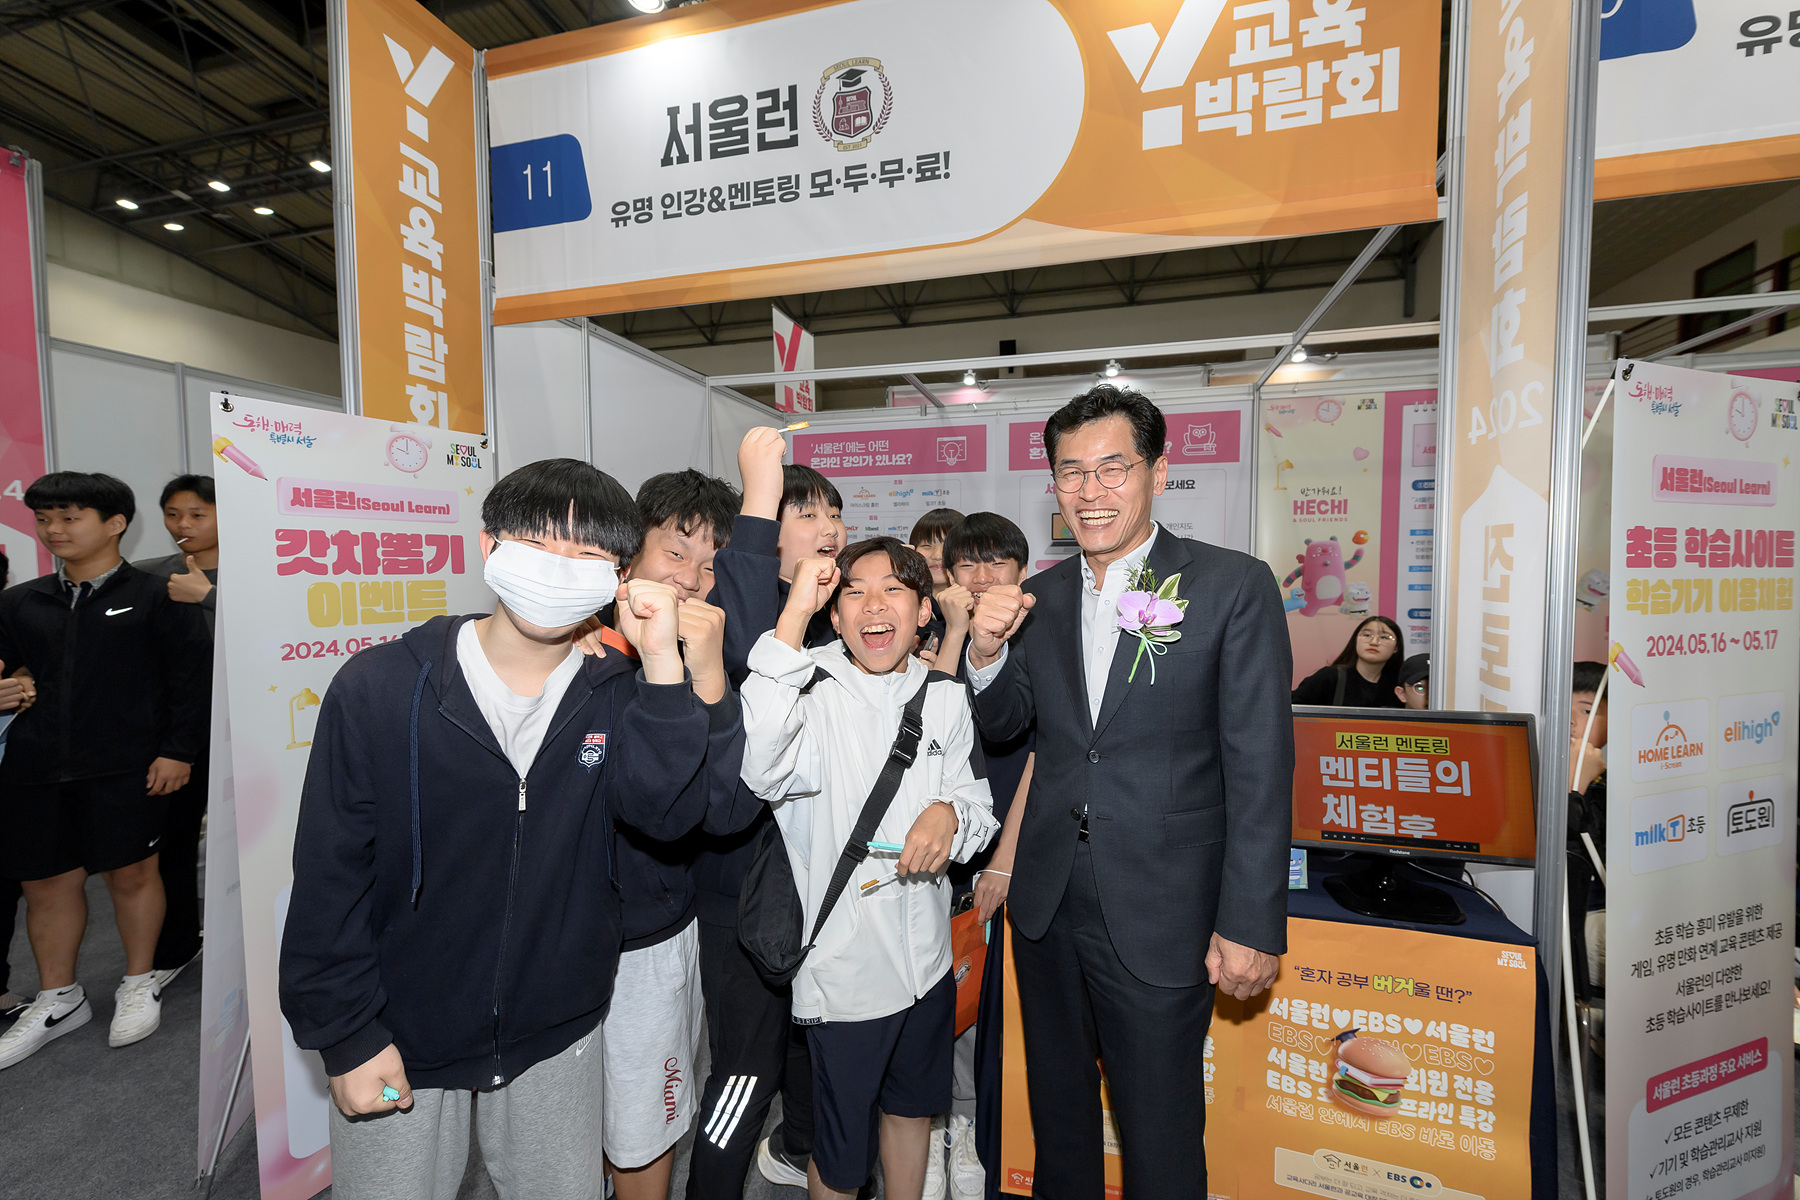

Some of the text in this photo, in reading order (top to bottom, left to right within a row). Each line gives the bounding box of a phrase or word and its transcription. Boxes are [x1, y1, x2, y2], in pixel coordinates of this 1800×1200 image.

[1195, 46, 1400, 136] 박람회
[660, 84, 799, 167] 서울런
[522, 160, 554, 201] 11
[610, 151, 951, 228] 유명 인강&멘토링 모·두·무·료!
[398, 141, 449, 428] 교육박람회
[269, 432, 318, 448] 특별시 서울
[810, 453, 913, 469] 온라인 강의가 있나요?
[868, 440, 889, 452] 어떤
[1293, 499, 1348, 515] HECHI
[1300, 486, 1342, 497] 반가워요!
[1739, 478, 1771, 496] Learn)
[408, 501, 450, 516] Learn)
[275, 528, 466, 576] 갓챠뽑기
[1626, 525, 1795, 568] 초등 학습사이트
[307, 580, 448, 628] 이벤트
[1626, 577, 1794, 615] 학습기기 이용체험
[1646, 632, 1727, 657] 2024.05.16
[1743, 629, 1779, 652] 05.17
[1337, 734, 1449, 754] 서울런 멘토링
[1724, 716, 1775, 744] elihigh
[1638, 742, 1703, 764] HOME LEARN
[1319, 755, 1471, 797] 멘티들의
[1322, 793, 1438, 839] 체험후
[1687, 815, 1706, 834] 초등
[1731, 805, 1771, 834] 토도원
[1654, 903, 1763, 946] 초등 학습 흥미 유발을 위한
[1656, 951, 1676, 973] 유명
[1677, 945, 1697, 967] 만화
[1698, 940, 1718, 960] 연계
[1719, 934, 1738, 954] 교육
[1738, 928, 1765, 949] 콘텐츠
[1766, 922, 1783, 940] 제공
[1337, 971, 1369, 989] 공부
[1373, 975, 1431, 998] 버거울
[1675, 963, 1743, 997] 서울런의 다양한
[1269, 997, 1495, 1054] 서울런 EBS 서울런
[1645, 1012, 1665, 1033] 초등
[1724, 979, 1771, 1009] 만나보세요!
[1268, 1021, 1473, 1072] EBS EBS
[664, 1057, 683, 1125] Miami
[1267, 1047, 1496, 1106] 서울런 회원 전용
[1653, 1048, 1763, 1101] 서울런 초등과정 주요 서비스
[1267, 1069, 1312, 1098] EBS
[1459, 1104, 1496, 1133] 특강
[1673, 1098, 1749, 1142] 모든 콘텐츠 무제한
[1266, 1094, 1496, 1161] 서울런 안에서 EBS 바로 이동
[1658, 1119, 1762, 1176] 기기 및 학습관리교사 지원
[1286, 1173, 1317, 1187] 교육사다리
[1319, 1182, 1343, 1194] 서울런과
[1344, 1160, 1369, 1173] 서울런
[1387, 1171, 1407, 1183] EBS
